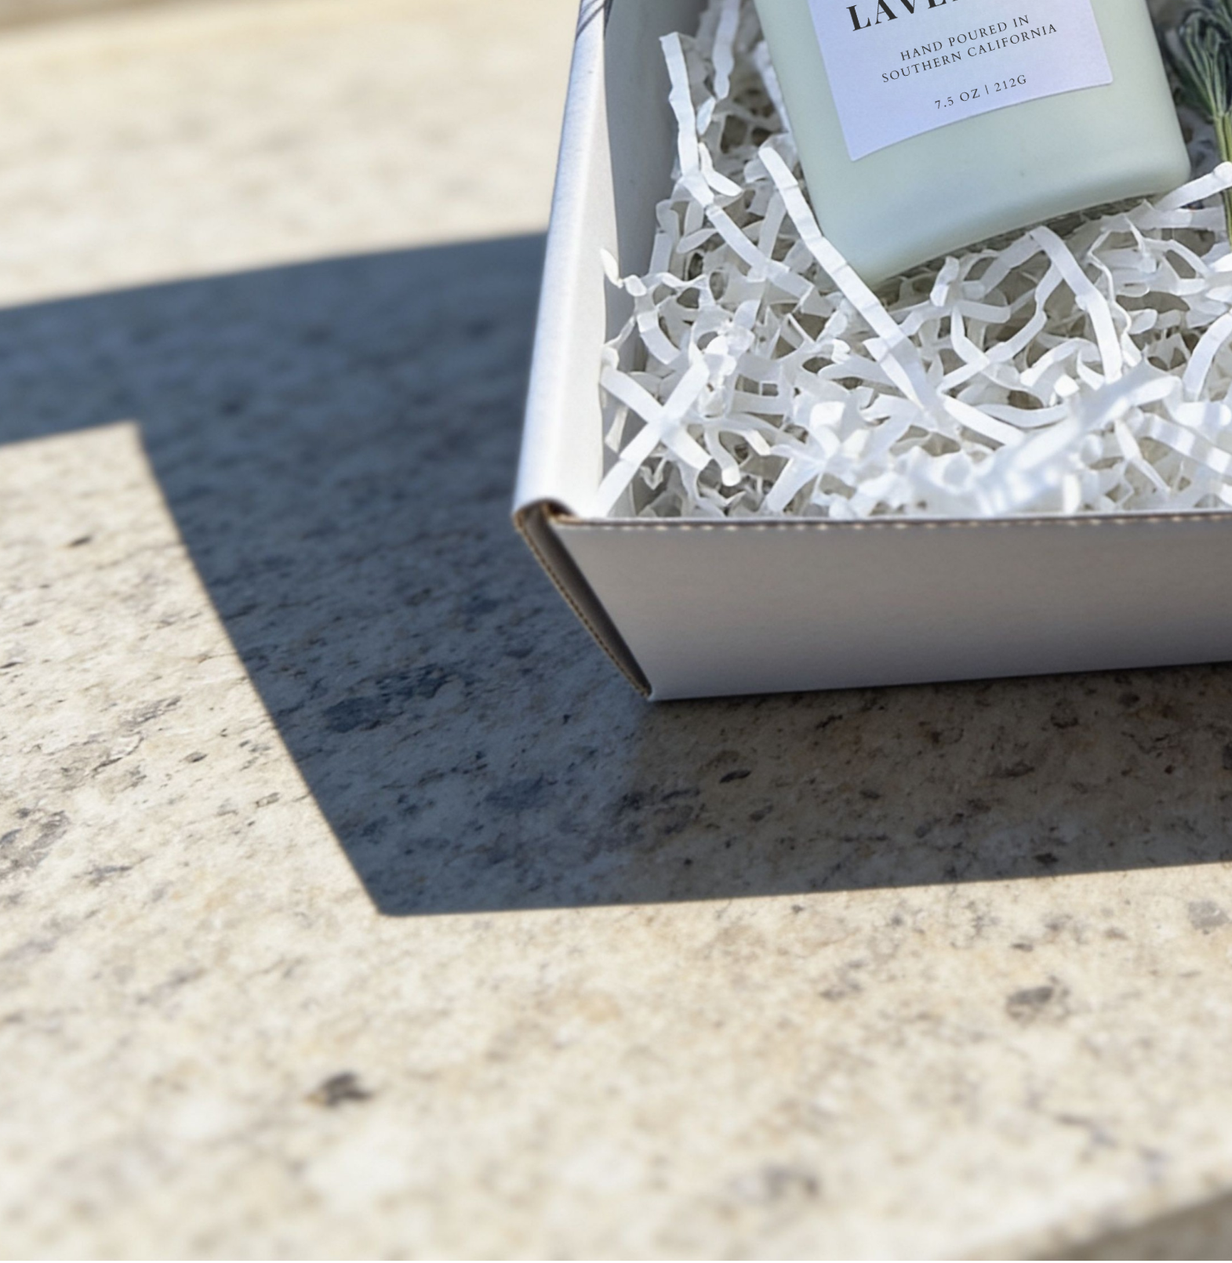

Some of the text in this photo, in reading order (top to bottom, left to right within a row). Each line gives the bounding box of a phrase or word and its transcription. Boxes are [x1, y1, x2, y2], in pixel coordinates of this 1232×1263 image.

[882, 24, 1057, 83] SOUTHERN CALIFORNIA
[900, 15, 1029, 62] HAND POURED IN
[935, 97, 954, 110] 7.5
[960, 88, 981, 103] OZ
[995, 74, 1027, 93] 212G
